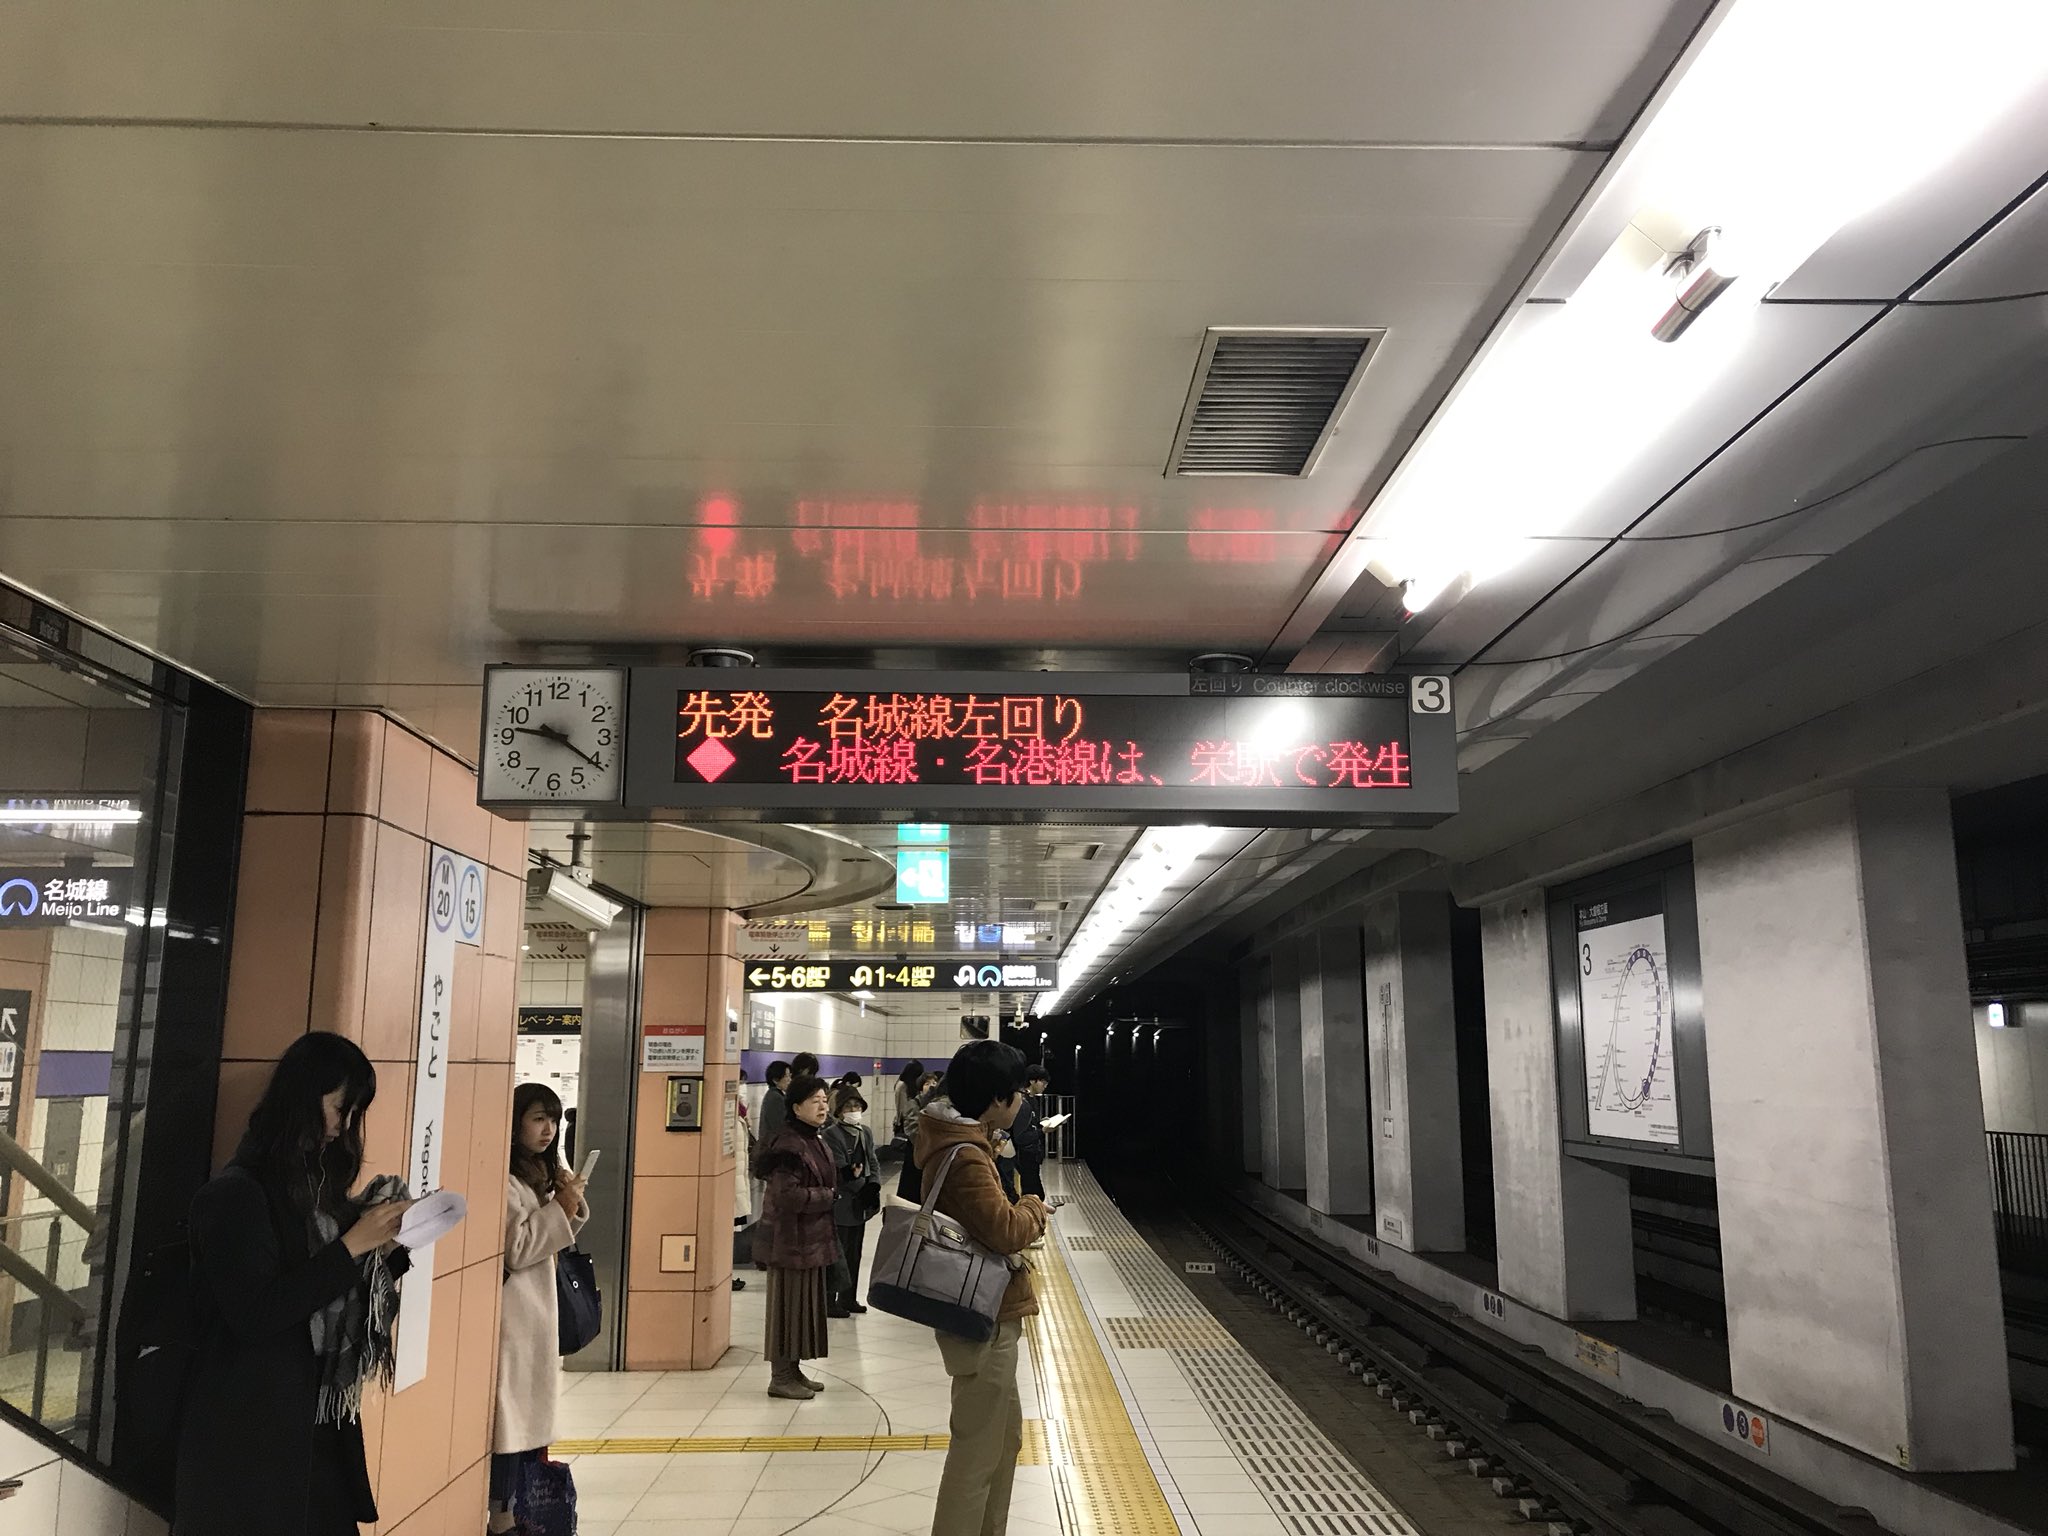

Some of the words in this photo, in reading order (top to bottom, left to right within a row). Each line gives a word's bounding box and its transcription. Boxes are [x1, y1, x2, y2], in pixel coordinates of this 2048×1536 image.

[547, 682, 571, 700] 12
[1253, 677, 1318, 694] Counter
[1325, 678, 1405, 694] clockwise
[1417, 677, 1446, 712] 3
[524, 689, 543, 707] 11
[578, 690, 587, 708] 1
[507, 706, 530, 725] 10
[591, 705, 606, 723] 2
[678, 691, 775, 739] 先発
[817, 692, 1082, 741] 名城線左回り
[501, 727, 515, 746] 9
[597, 728, 612, 746] 3
[507, 750, 521, 769] 8
[587, 751, 602, 768] 4
[525, 767, 540, 785] 7
[546, 773, 561, 791] 6
[570, 766, 585, 785] 5
[441, 863, 450, 885] M
[469, 873, 476, 893] T
[43, 878, 109, 902] 名城線
[41, 902, 82, 919] Meijo
[86, 902, 120, 917] Line
[436, 889, 450, 918] 20
[465, 898, 476, 925] 15
[1583, 943, 1592, 976] 3
[428, 974, 444, 1079] やごと
